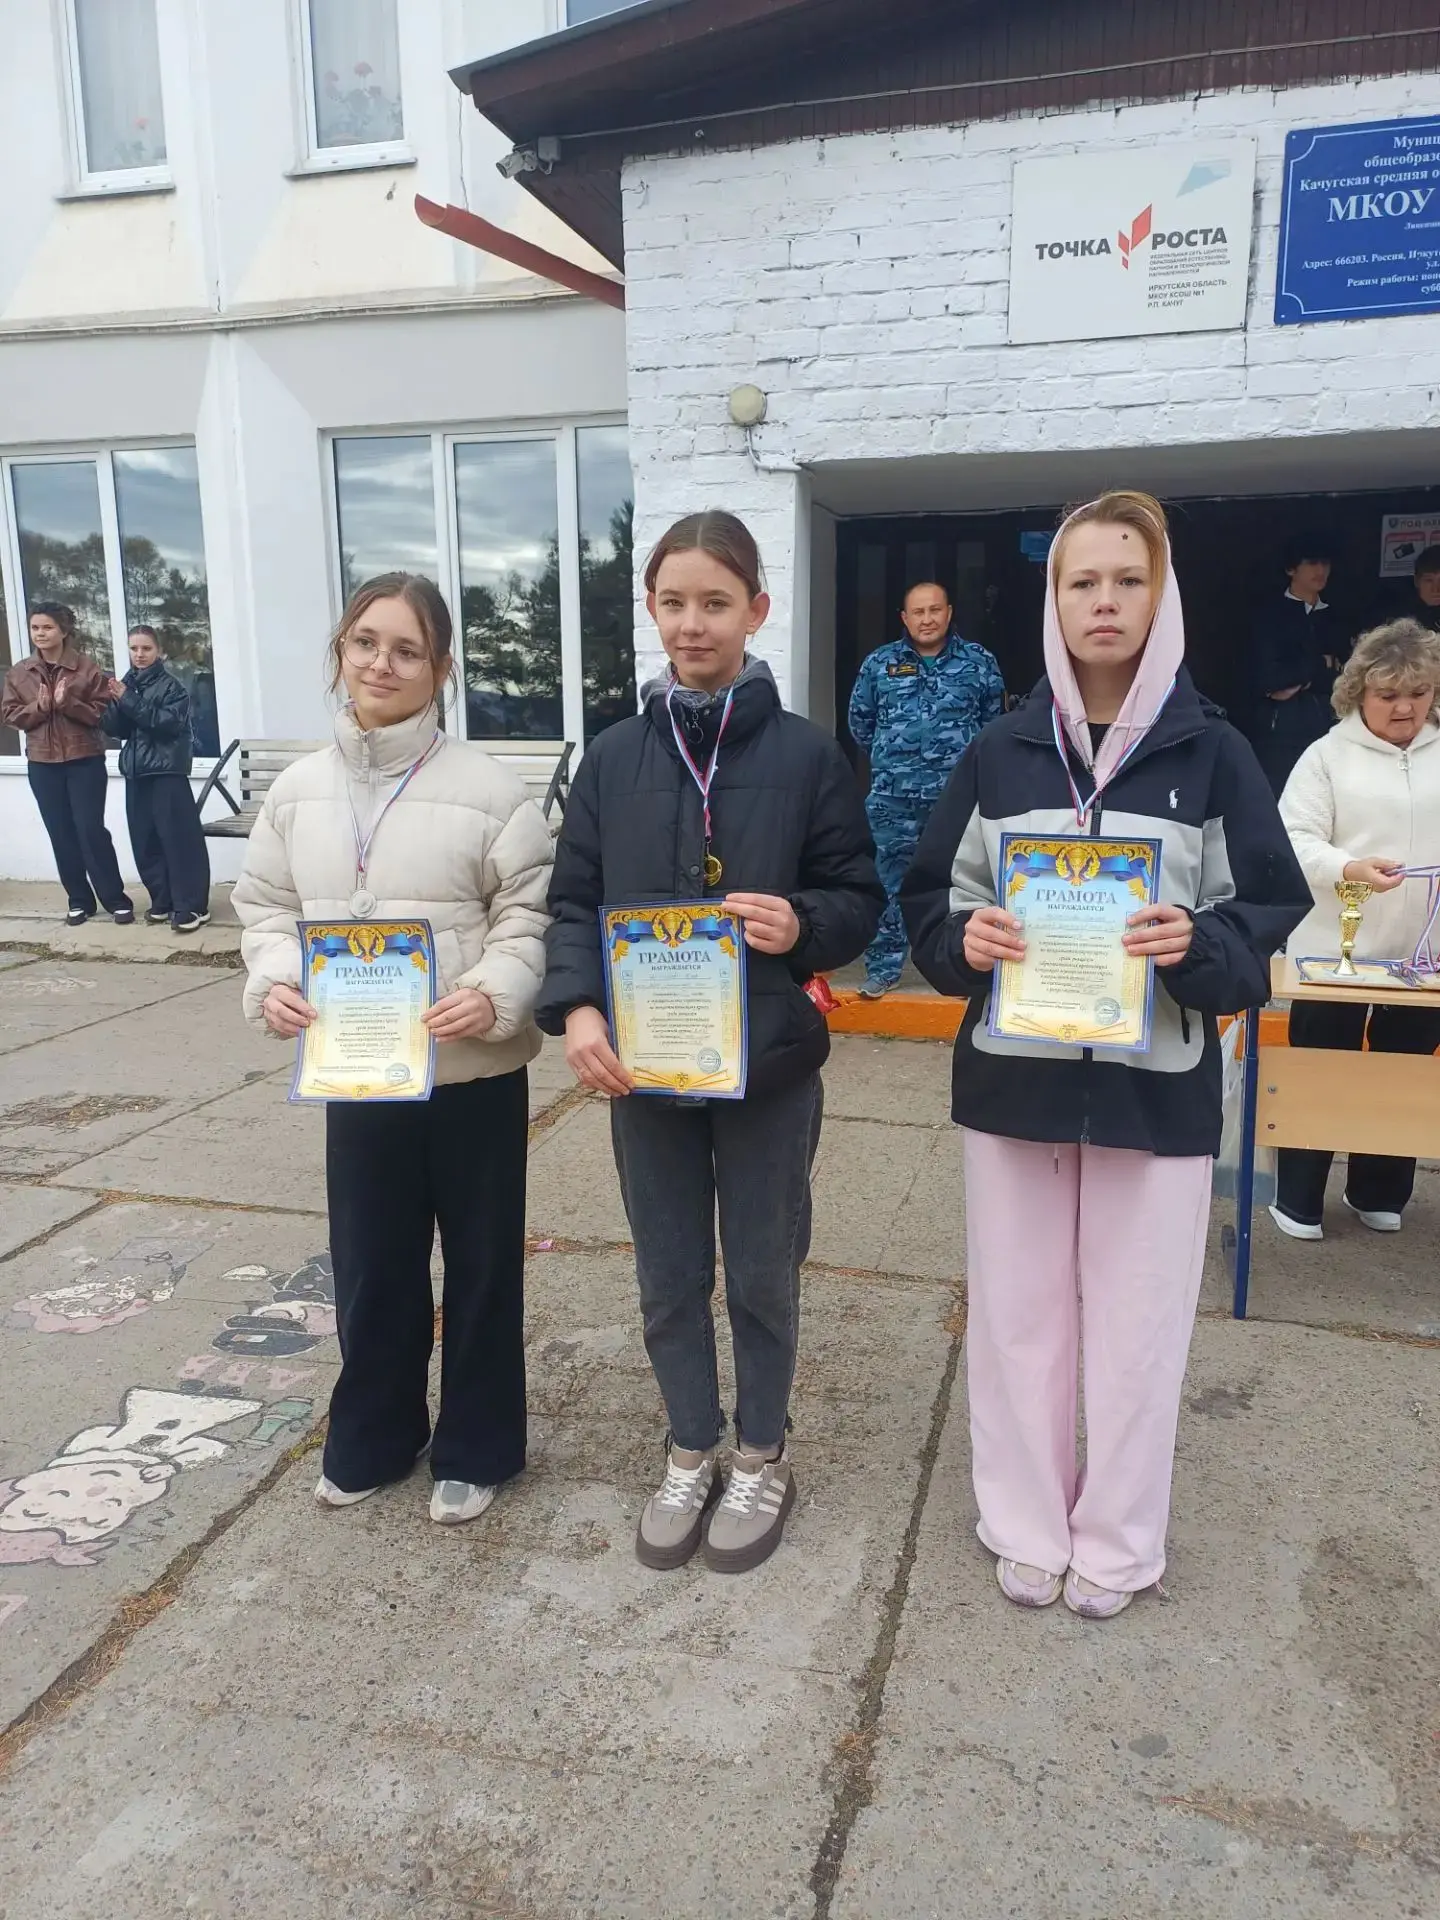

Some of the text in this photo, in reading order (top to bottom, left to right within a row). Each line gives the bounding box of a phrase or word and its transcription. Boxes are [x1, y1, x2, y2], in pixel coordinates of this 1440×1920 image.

[1299, 175, 1370, 192] Качугская
[1374, 169, 1429, 187] средняя
[1326, 187, 1436, 223] МКОУ
[1035, 226, 1228, 260] ТОЧКА РОСТА
[1302, 258, 1333, 271] Адрес:
[1148, 279, 1227, 291] ИРКУТСКАЯ ОБЛАСТЬ
[1346, 277, 1378, 288] Режим
[1380, 273, 1419, 287] работы:
[1148, 292, 1168, 300] МКОУ
[1169, 290, 1192, 298] КСОШ
[1162, 299, 1184, 308] КАЧУГ
[1036, 888, 1119, 904] ГРАМОТА
[1047, 903, 1105, 912] НАГРАЖДАЕТСЯ
[638, 950, 712, 964] ГРАМОТА
[335, 966, 404, 979] ГРАМОТА
[345, 978, 393, 986] НАГРАЖДАЕТСЯ
